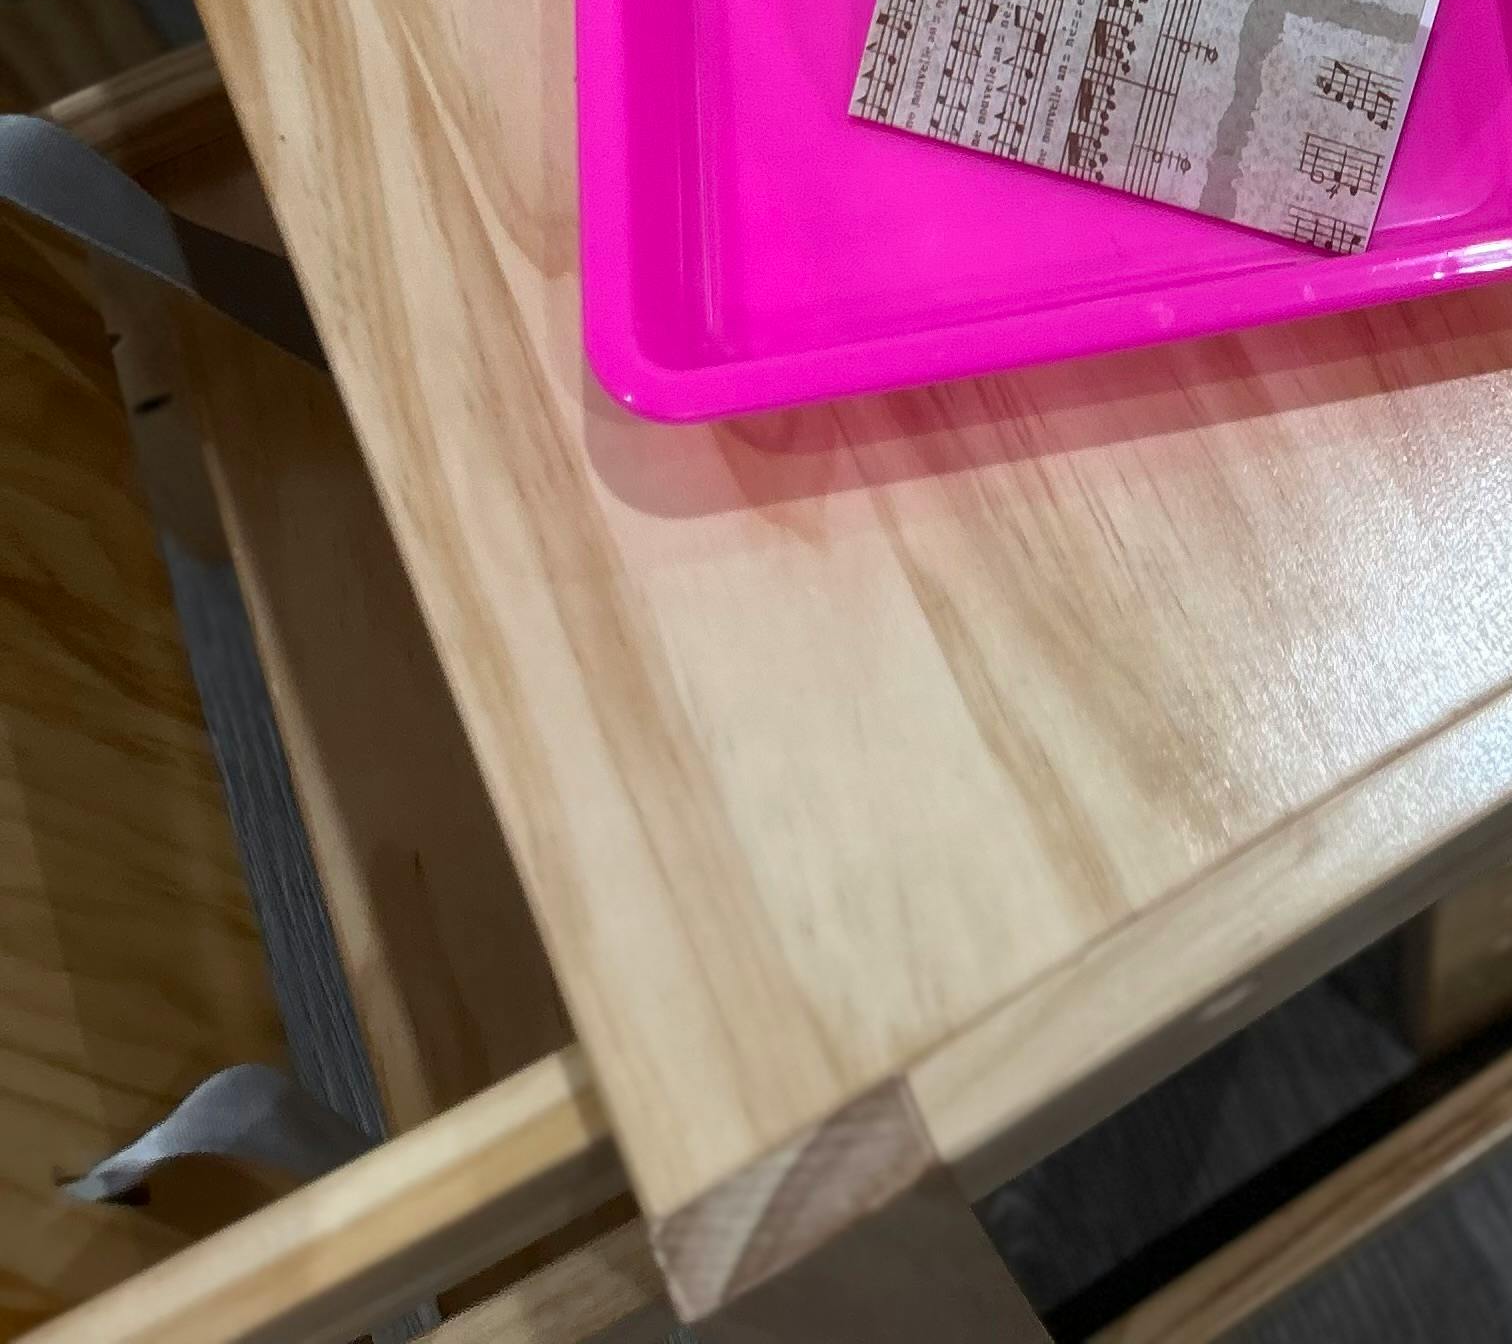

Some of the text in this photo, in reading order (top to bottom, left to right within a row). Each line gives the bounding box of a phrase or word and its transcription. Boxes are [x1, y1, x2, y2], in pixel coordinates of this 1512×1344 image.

[910, 46, 934, 107] nouvelle
[974, 64, 999, 125] nouvelle
[1040, 83, 1063, 143] nouvelle
